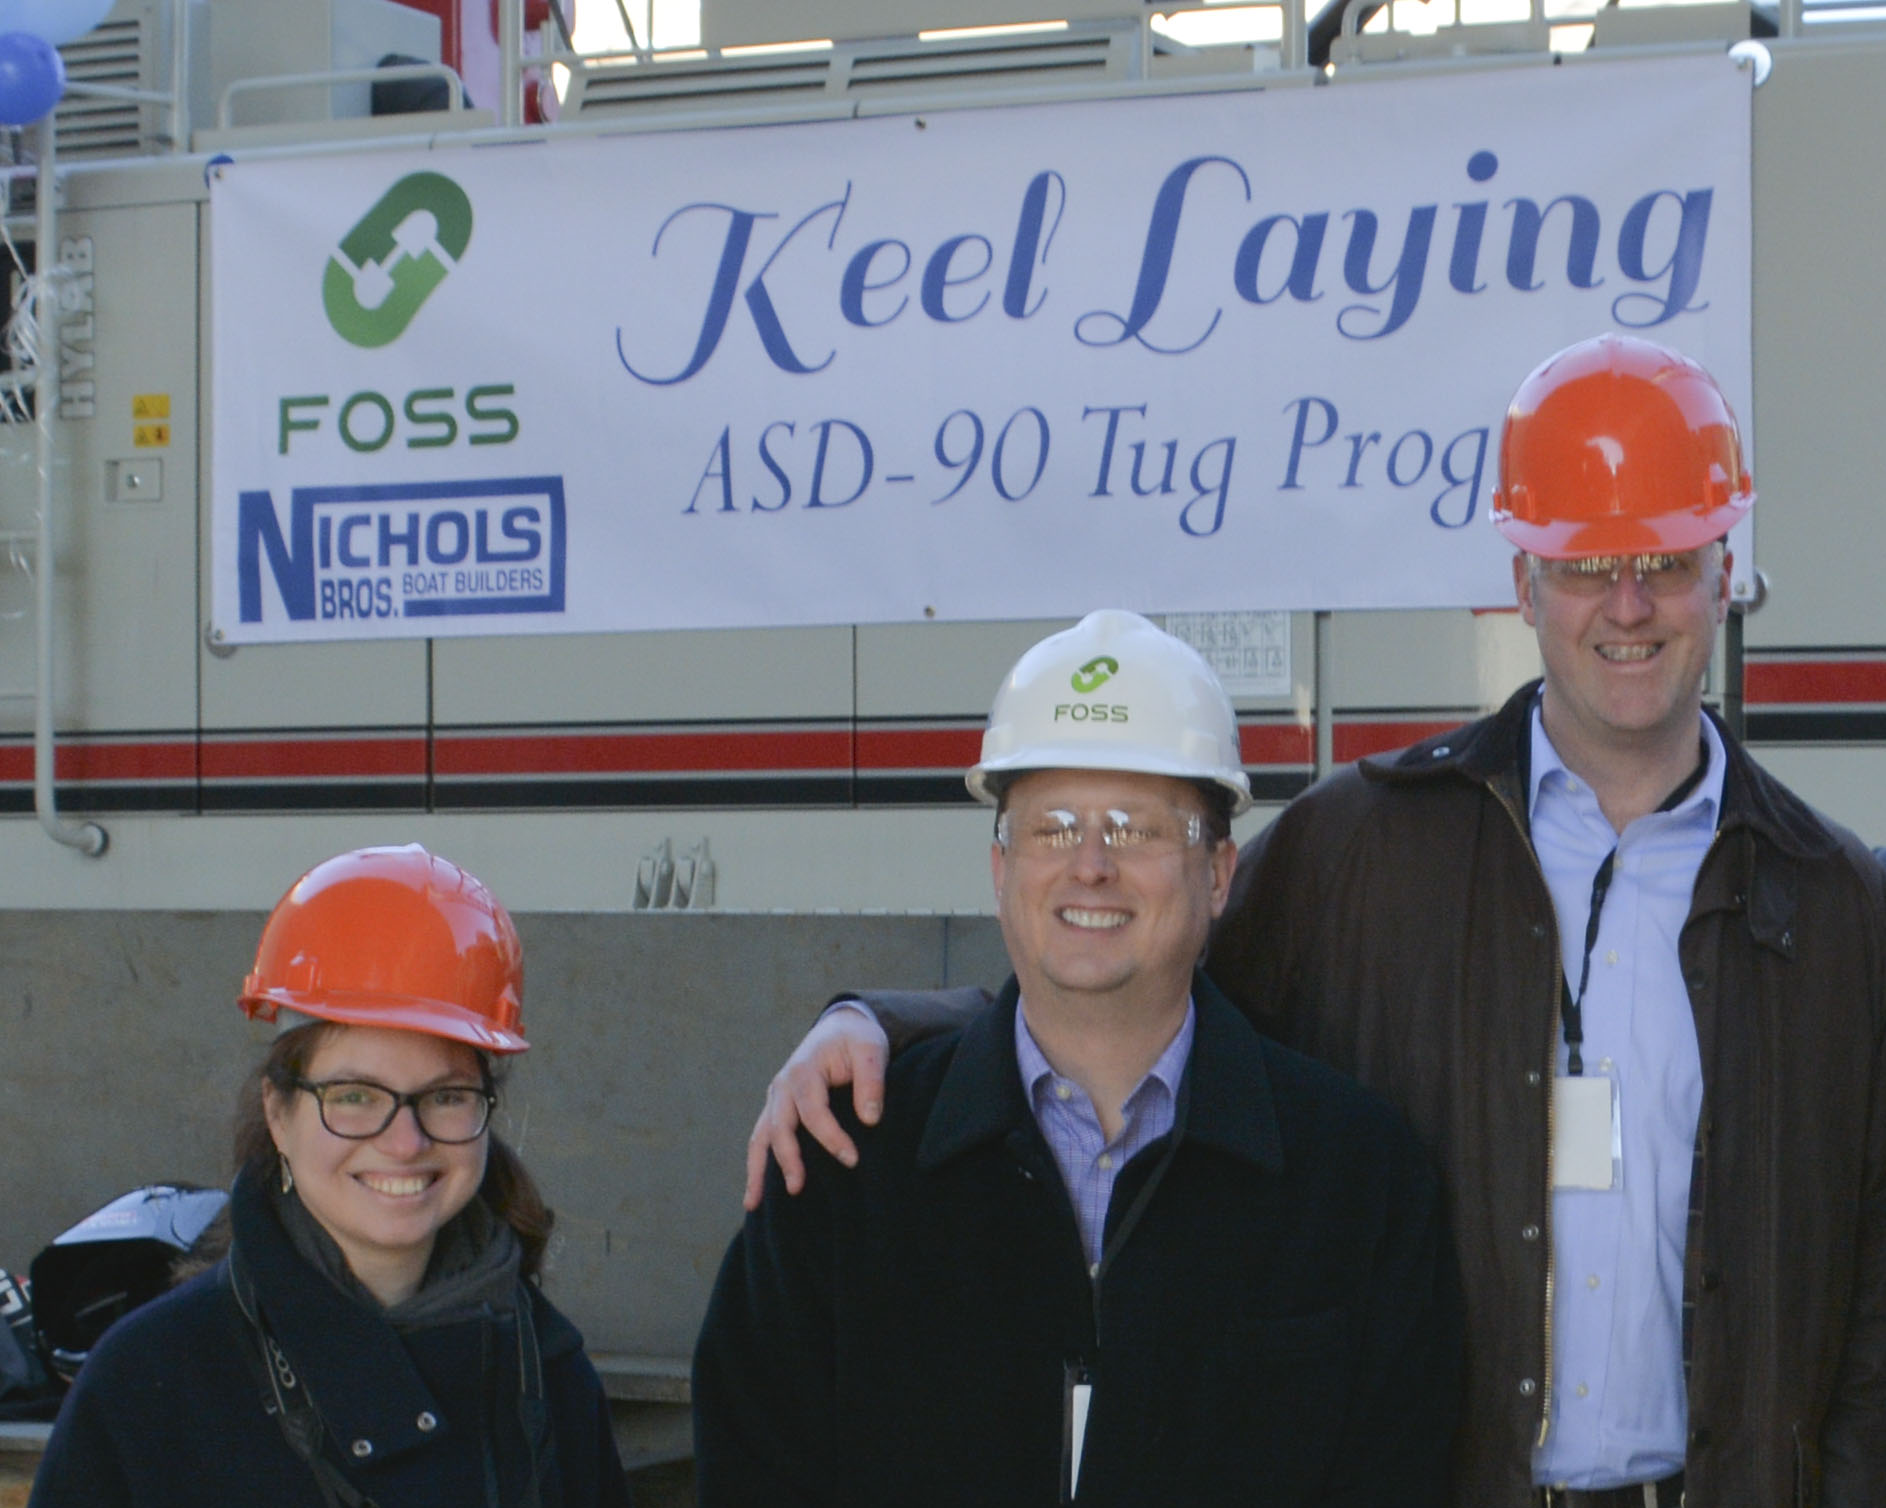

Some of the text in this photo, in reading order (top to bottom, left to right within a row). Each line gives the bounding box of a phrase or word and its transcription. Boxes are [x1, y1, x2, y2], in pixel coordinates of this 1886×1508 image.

[616, 150, 1714, 386] Keel Laying
[278, 383, 520, 455] FOSS
[681, 396, 1491, 537] ASD-90 Tug Prog
[238, 488, 543, 624] NICHOLS
[402, 568, 543, 594] BOAT BUILDERS
[319, 577, 399, 620] BROS.
[1053, 703, 1130, 722] FOSS
